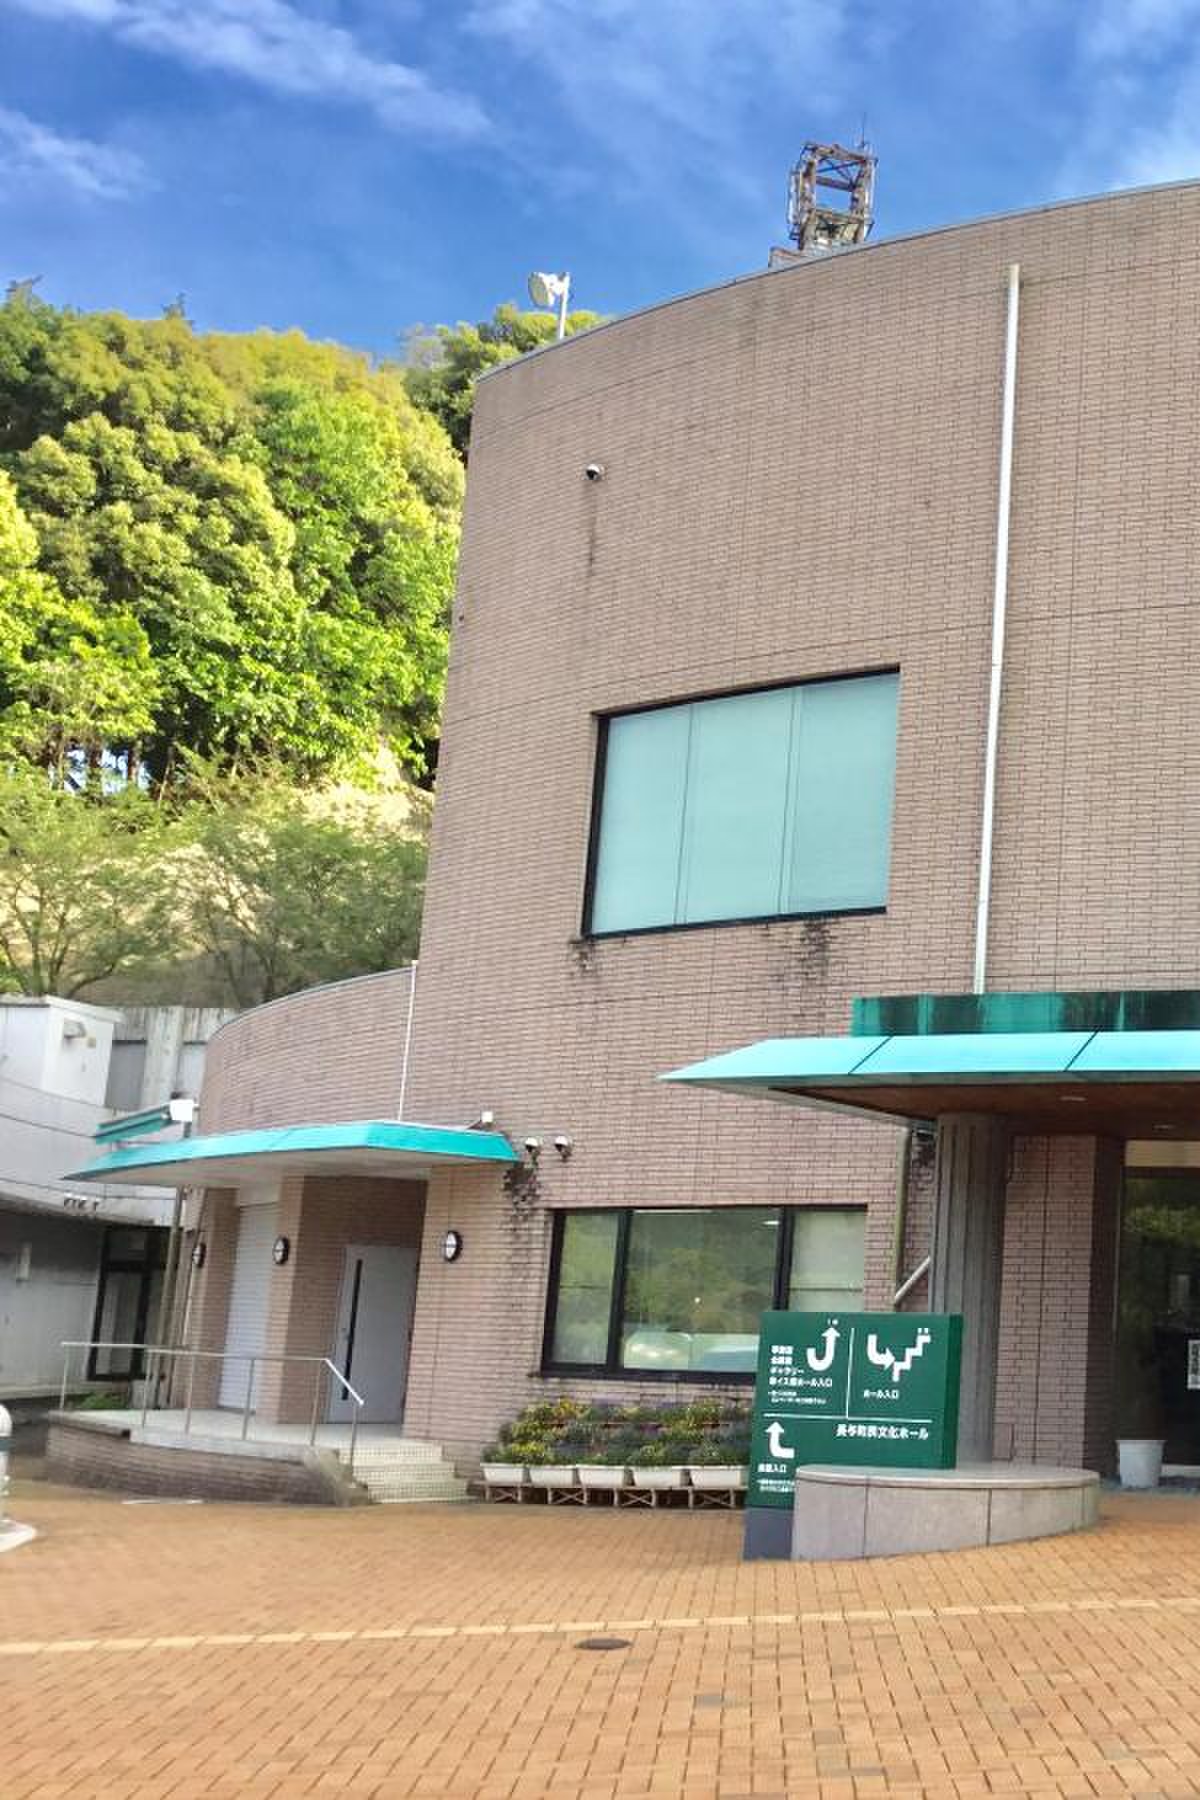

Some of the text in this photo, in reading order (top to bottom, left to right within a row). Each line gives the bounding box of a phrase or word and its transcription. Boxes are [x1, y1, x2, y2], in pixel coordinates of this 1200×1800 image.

[863, 1389, 899, 1400] ホール入口
[835, 1424, 929, 1441] 長与町民文化ホール
